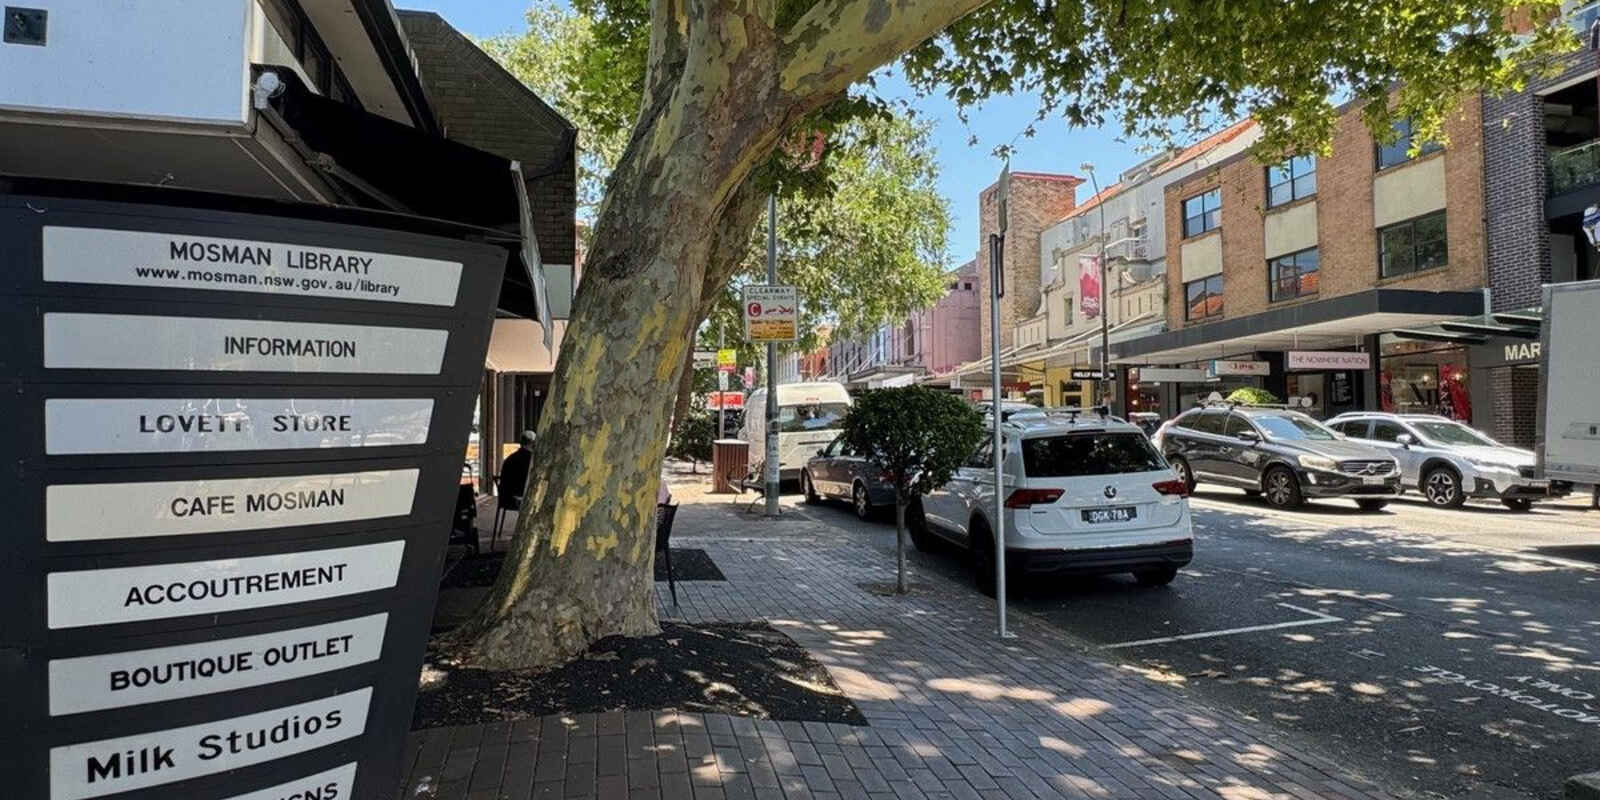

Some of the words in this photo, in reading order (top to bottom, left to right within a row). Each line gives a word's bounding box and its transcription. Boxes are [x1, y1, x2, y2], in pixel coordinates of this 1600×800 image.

[170, 241, 272, 265] MOSMAN
[287, 249, 374, 274] LIBRARY
[136, 265, 401, 297] www.mosman.nsw.gov.au/library
[749, 287, 791, 295] CLEARWAY
[224, 336, 356, 358] INFORMATION
[139, 415, 244, 433] LOVETT
[273, 415, 352, 432] STORE
[171, 495, 235, 517] CAFE
[246, 489, 345, 513] MOSMAN
[124, 563, 347, 606] ACCOUTREMENT
[110, 651, 253, 692] BOUTIQUE
[263, 634, 353, 668] OUTLET
[87, 745, 176, 784] Milk
[197, 708, 343, 761] Studios
